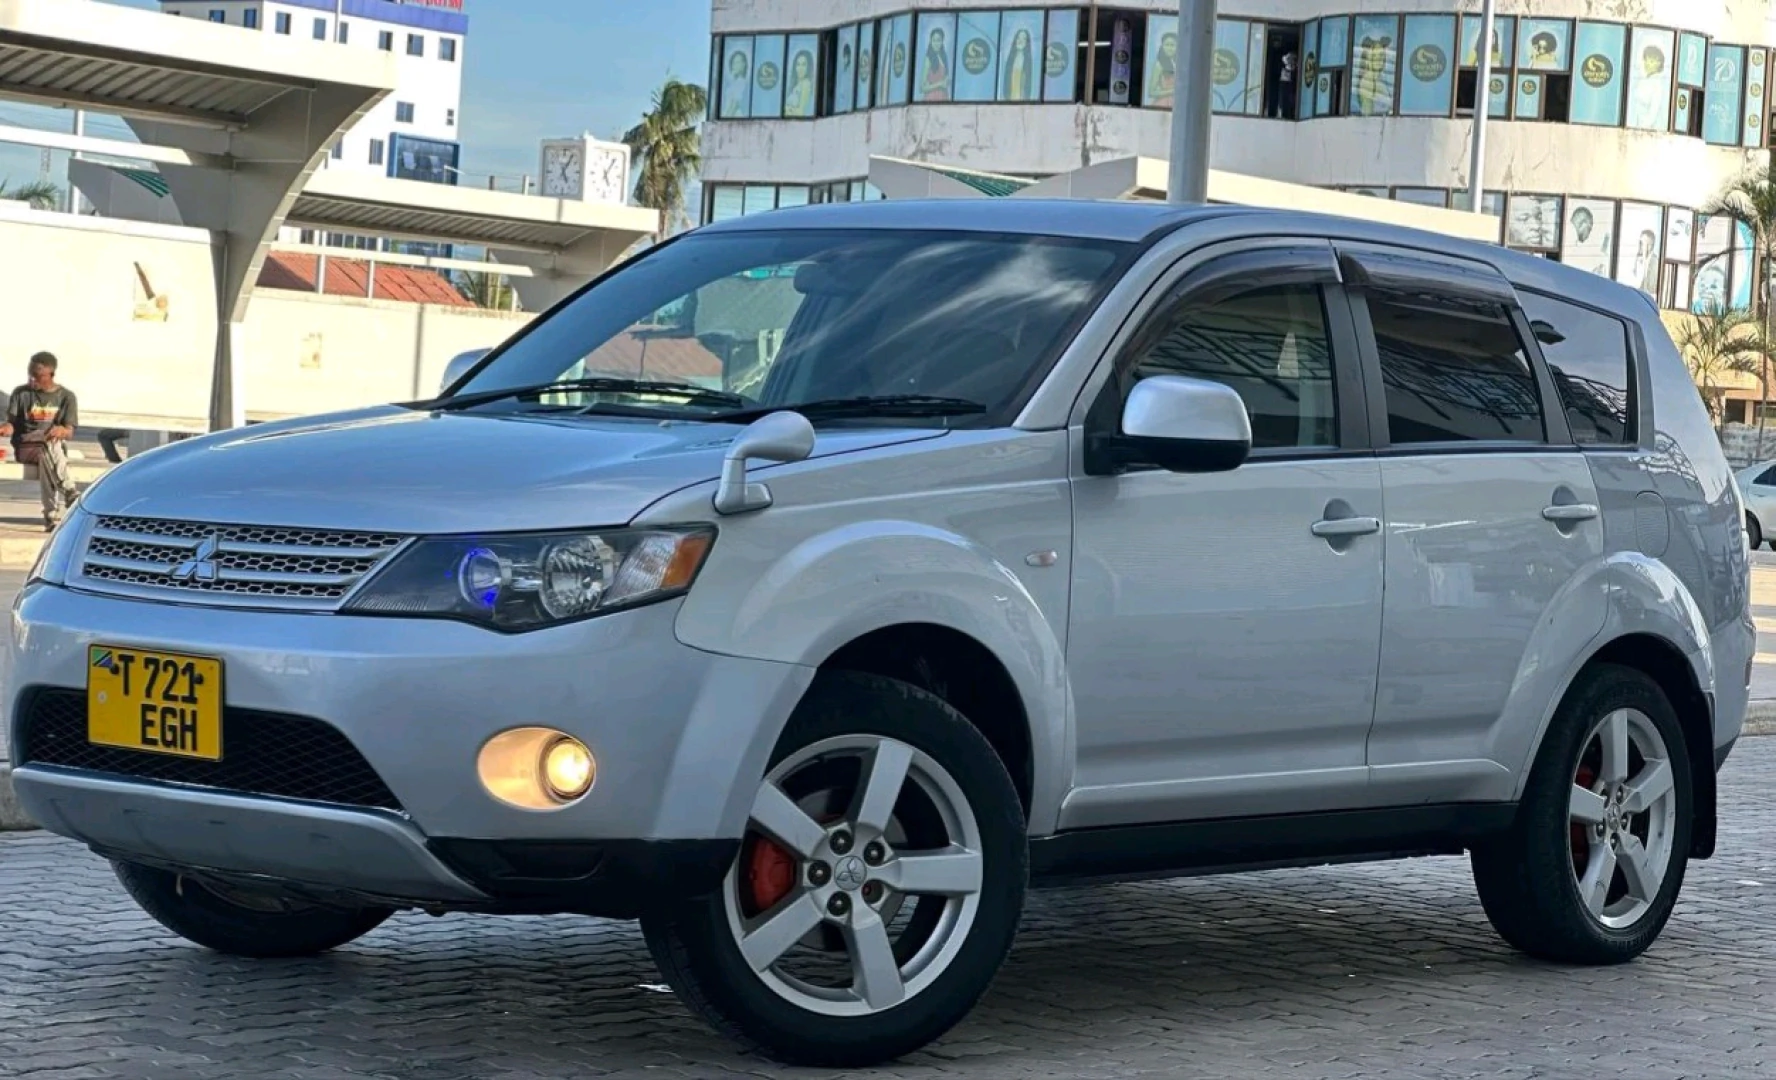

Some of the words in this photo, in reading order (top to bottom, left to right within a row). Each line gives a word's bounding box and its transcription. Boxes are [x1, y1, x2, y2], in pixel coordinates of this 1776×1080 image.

[118, 654, 135, 696] T
[144, 657, 198, 704] 721
[141, 703, 198, 751] EGH
